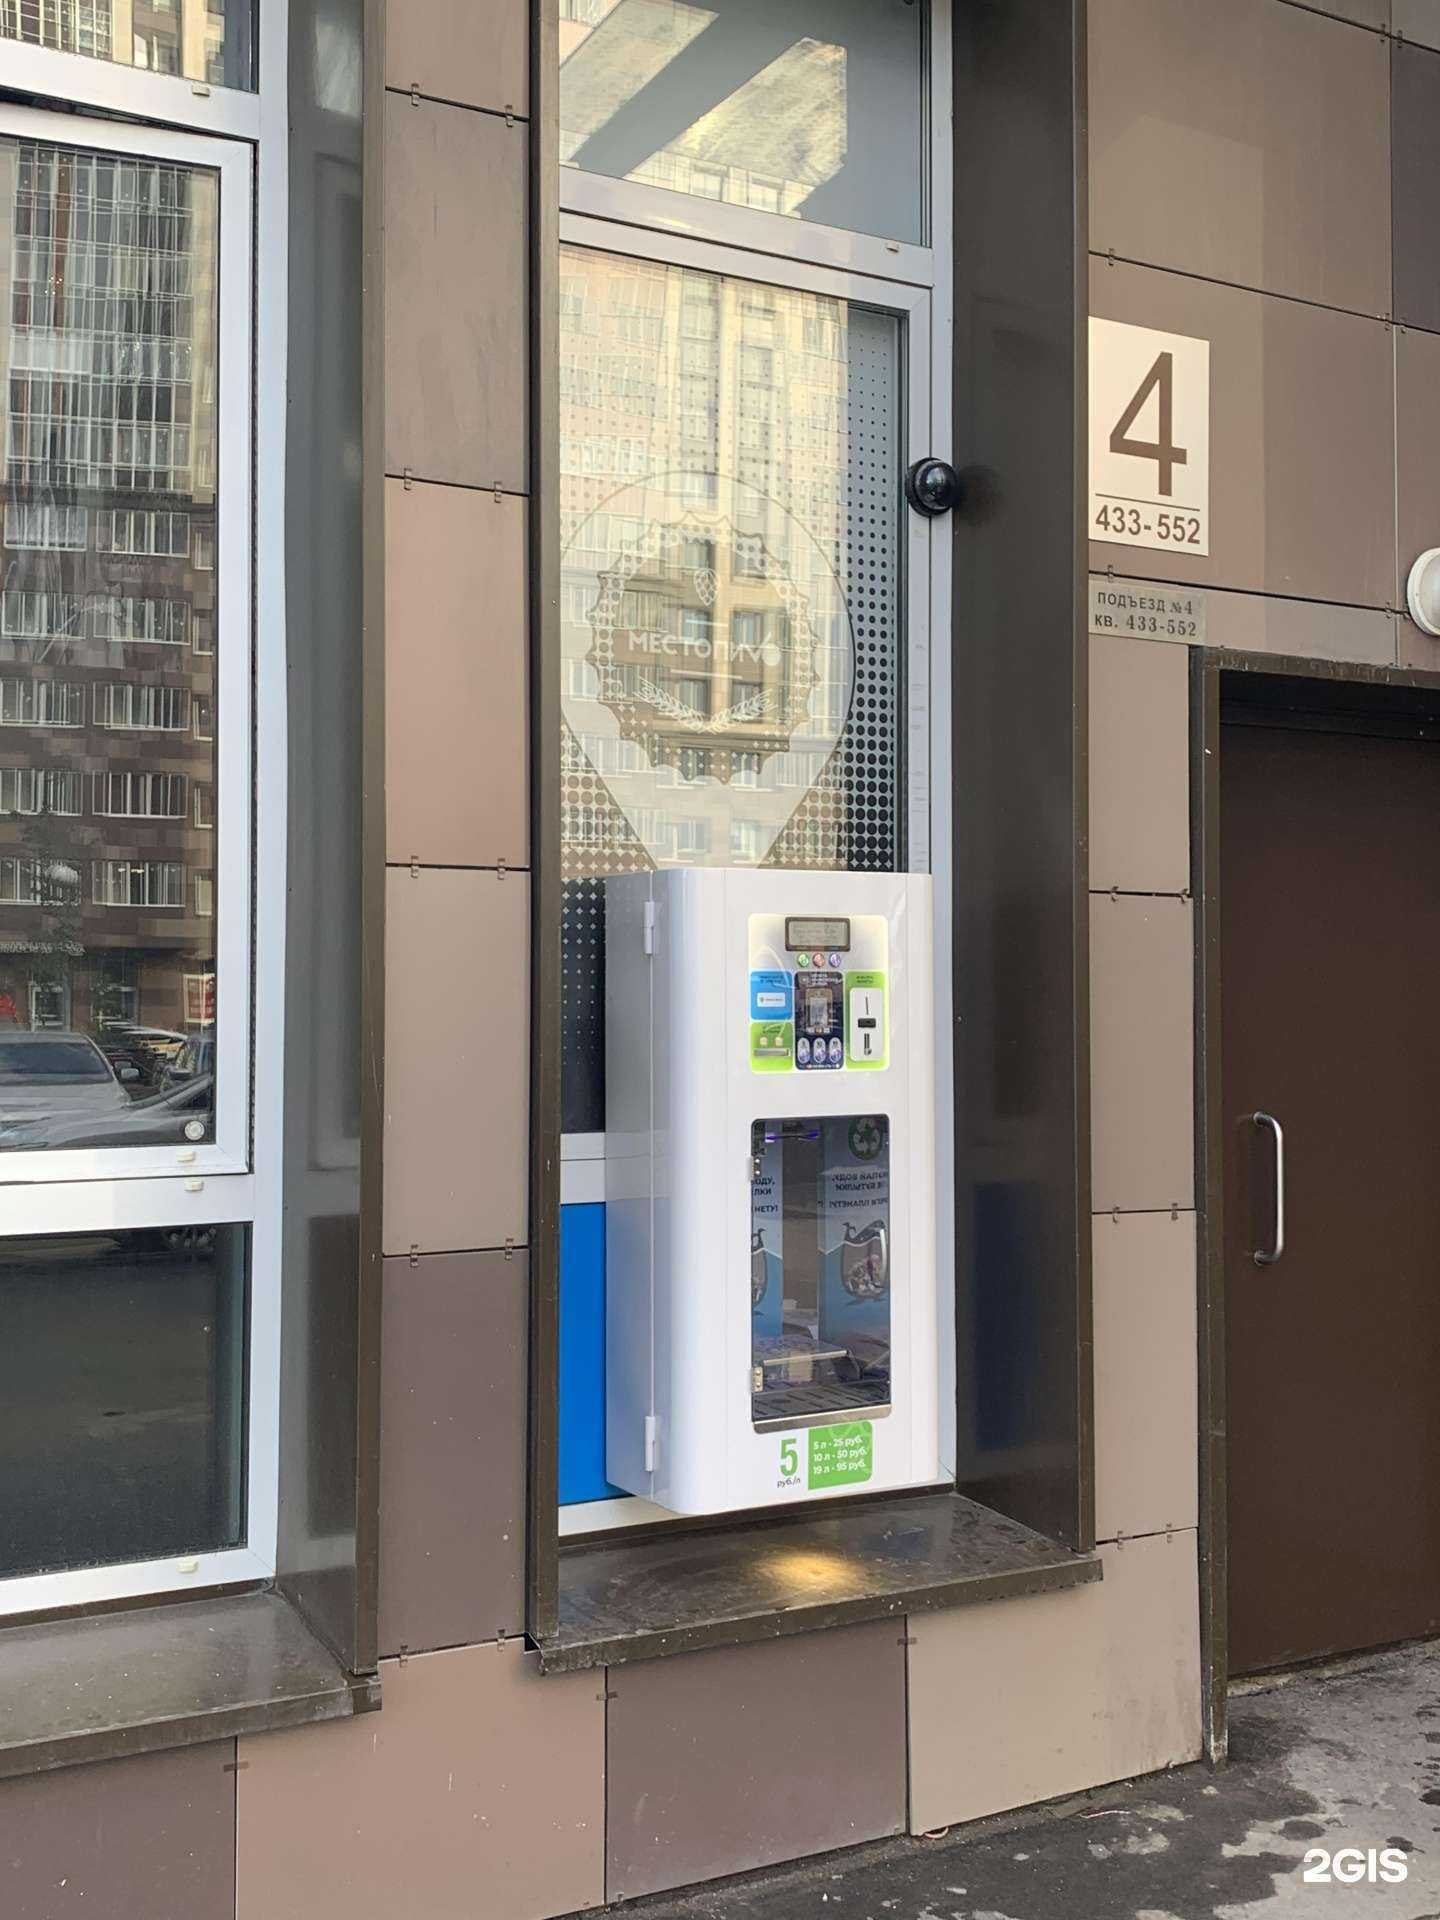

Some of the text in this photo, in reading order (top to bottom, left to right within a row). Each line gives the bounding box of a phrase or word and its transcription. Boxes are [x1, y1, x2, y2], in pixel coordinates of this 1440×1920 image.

[1109, 351, 1188, 497] 4
[1095, 504, 1201, 545] 433-552
[1097, 591, 1166, 614] ПОДЪЕЗД
[1094, 613, 1197, 637] КВ. 433-552
[780, 1438, 799, 1477] 5
[813, 1453, 823, 1463] 10
[837, 1449, 848, 1459] 50
[813, 1465, 823, 1475] 19
